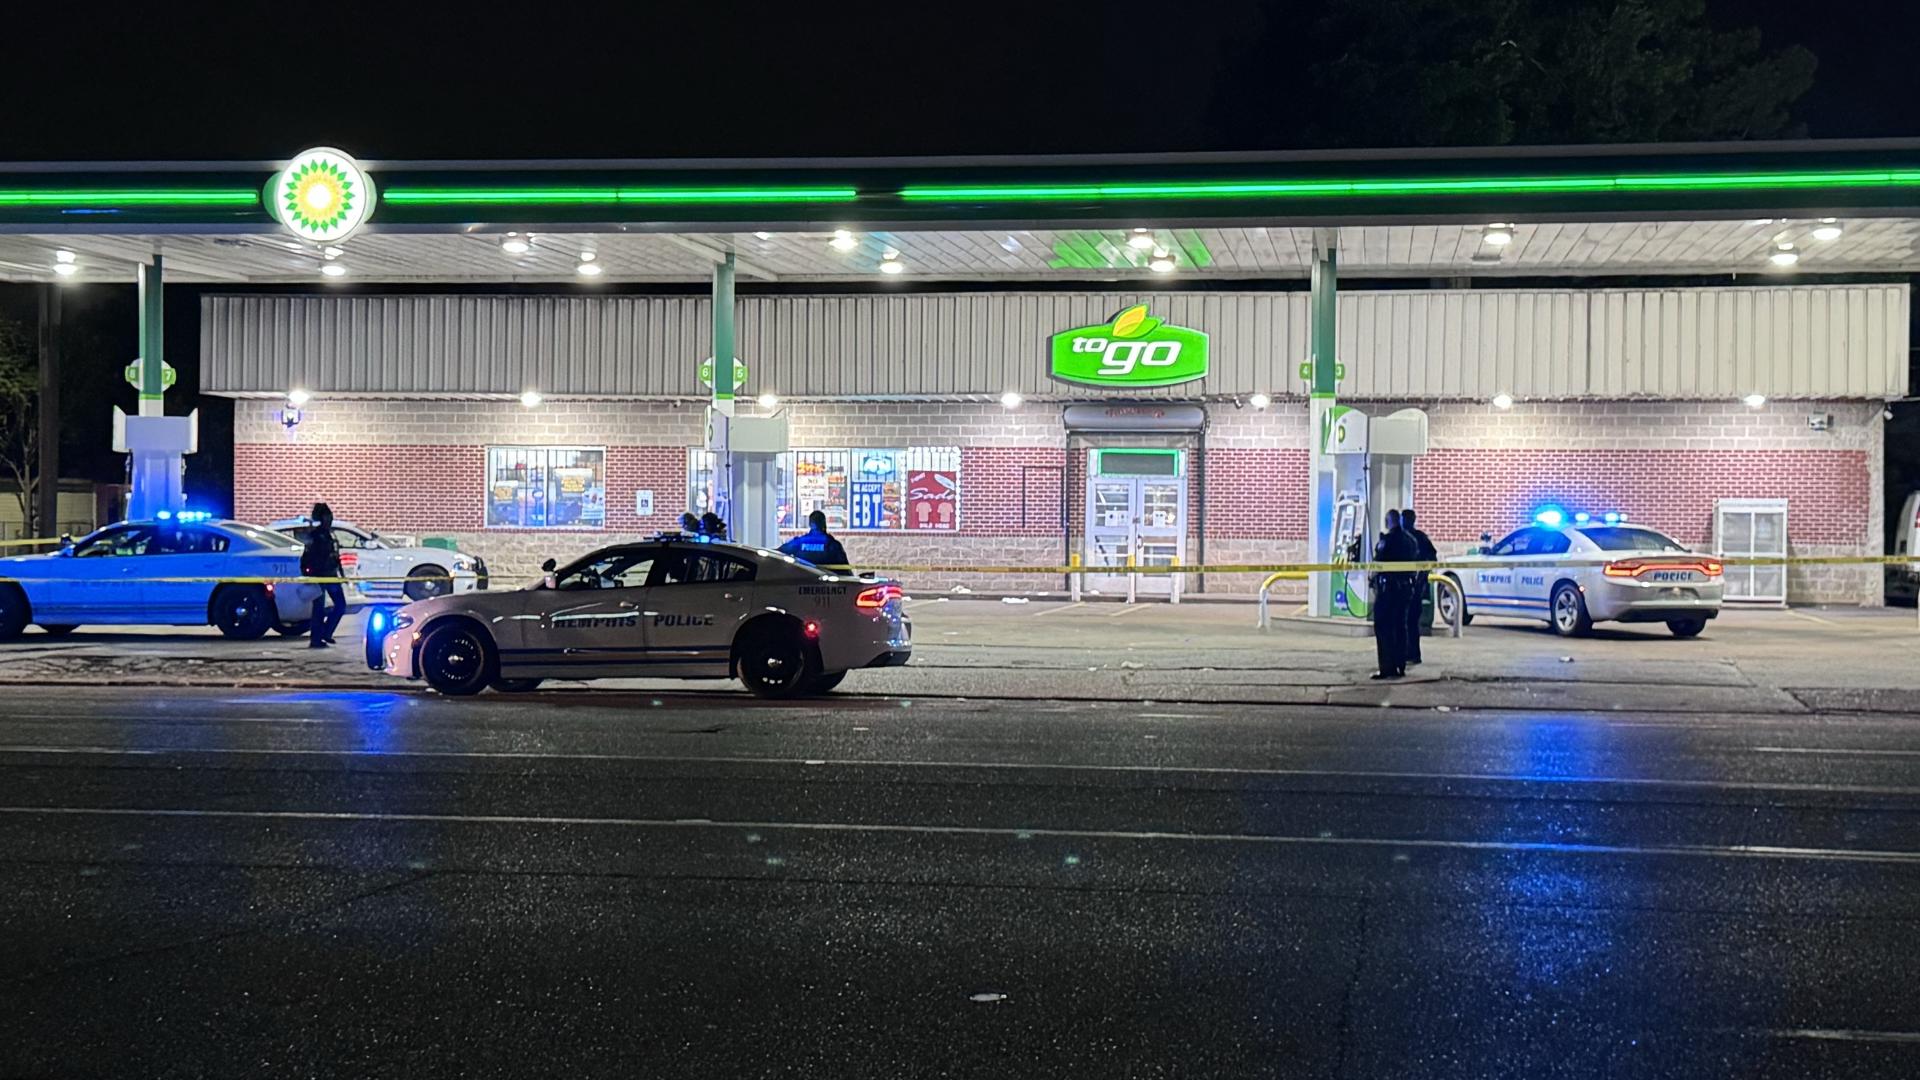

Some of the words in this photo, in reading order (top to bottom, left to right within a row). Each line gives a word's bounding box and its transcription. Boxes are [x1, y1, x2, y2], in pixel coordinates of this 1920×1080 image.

[1072, 337, 1108, 353] to
[1097, 341, 1182, 375] go
[164, 370, 173, 381] 7
[1302, 365, 1309, 375] 4
[853, 494, 881, 527] EBT
[1521, 575, 1544, 586] POLICE
[1653, 571, 1693, 581] POLICE
[798, 586, 847, 596] EMERGENCY
[653, 613, 714, 628] POLICE
